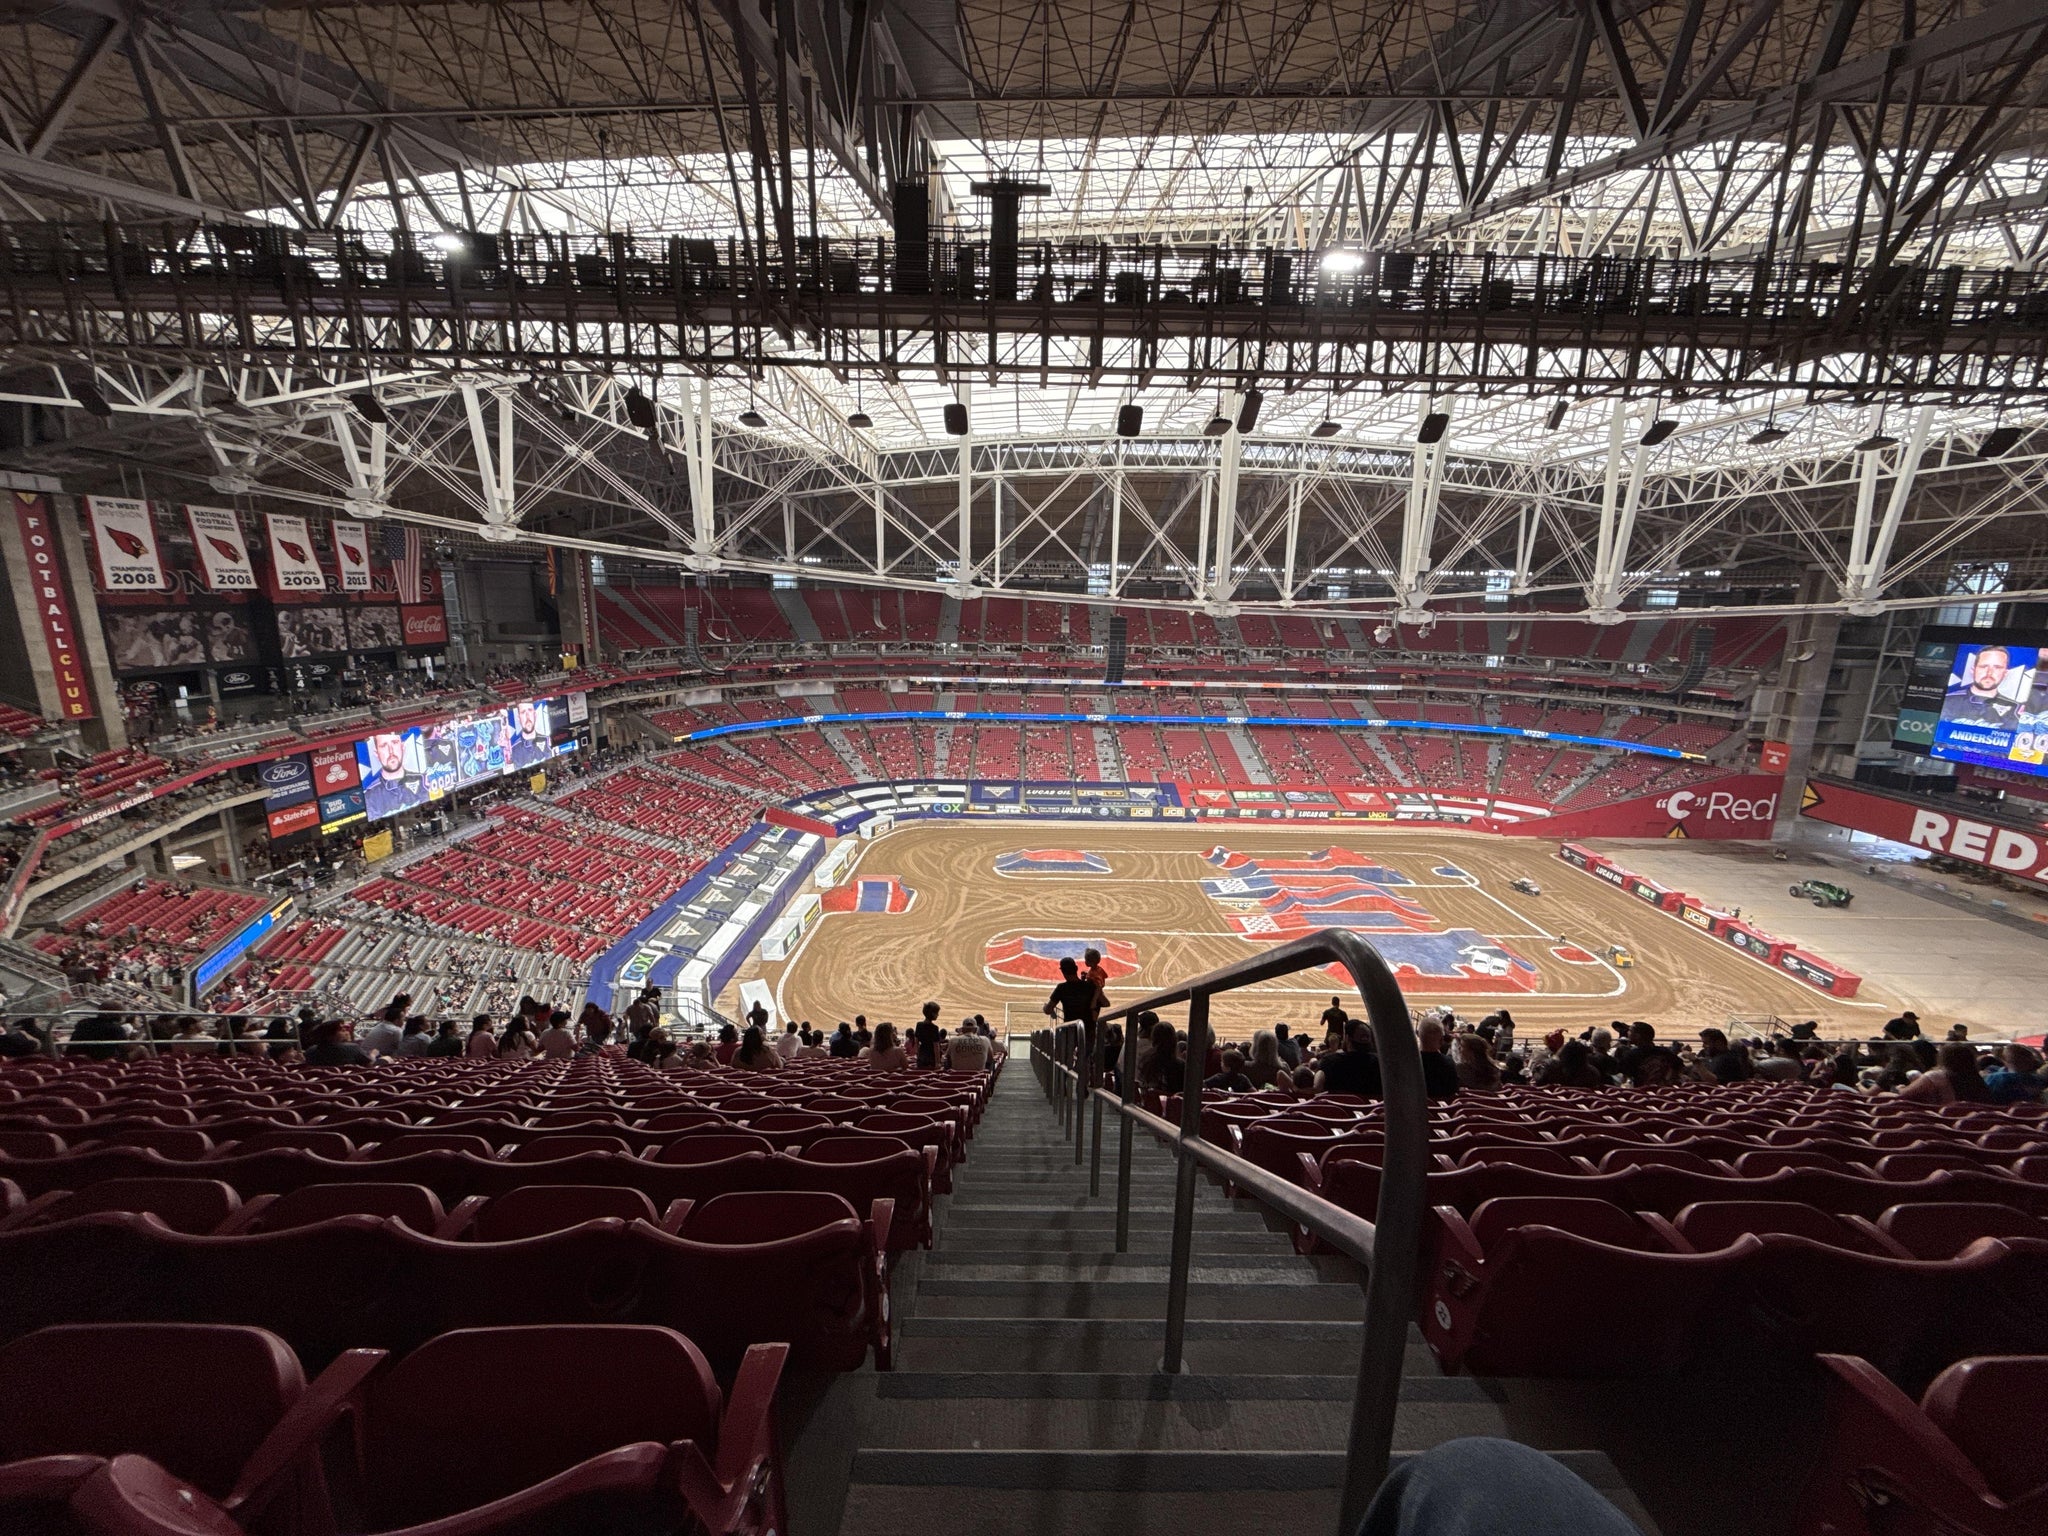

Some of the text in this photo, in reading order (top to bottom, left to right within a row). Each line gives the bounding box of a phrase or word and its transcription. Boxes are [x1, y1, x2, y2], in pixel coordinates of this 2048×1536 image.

[115, 502, 140, 510] WEST
[193, 510, 231, 520] NATIONAL
[195, 517, 233, 526] FOOTBALL
[27, 517, 68, 649] FOOTBALL
[111, 573, 157, 584] 2008
[217, 574, 252, 585] 2008
[283, 576, 320, 586] 2009
[346, 576, 367, 586] 2015
[406, 615, 441, 634] Coca-Cola
[60, 654, 84, 714] CLUB
[1900, 720, 1934, 734] COX
[1949, 730, 2009, 747] ANDERSON
[1990, 730, 2012, 738] RYAN
[81, 791, 154, 826] MARSHALL GOLDBERG
[326, 803, 346, 815] LIGHT
[328, 799, 343, 808] BUD
[933, 803, 961, 813] COX
[1706, 791, 1777, 821] Red
[1909, 809, 2048, 880] RED
[1595, 866, 1622, 884] LUCAS OIL
[1686, 910, 1709, 926] JCB
[624, 954, 655, 980] COX
